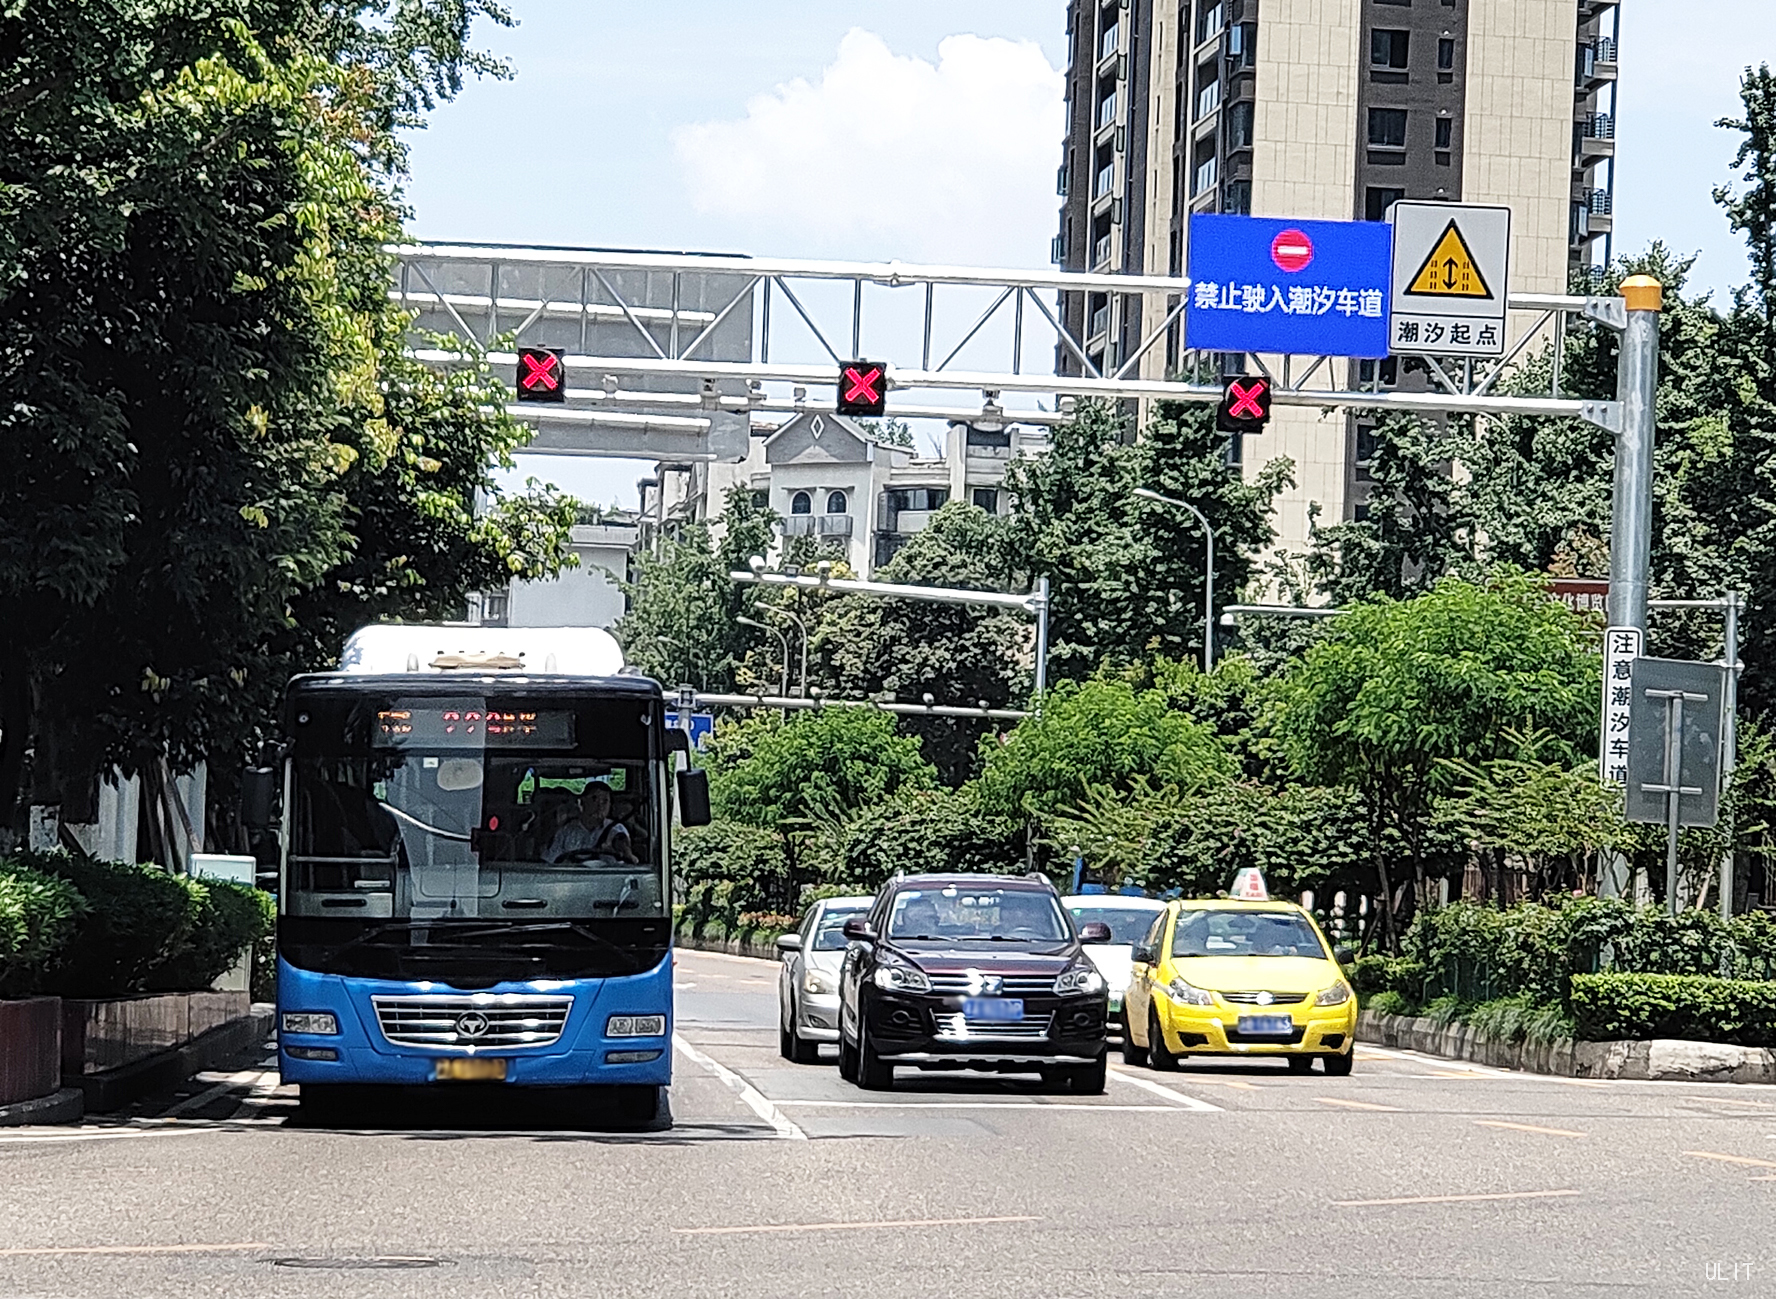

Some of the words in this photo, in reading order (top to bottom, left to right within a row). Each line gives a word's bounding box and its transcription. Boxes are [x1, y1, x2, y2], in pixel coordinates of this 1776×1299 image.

[1194, 281, 1383, 318] 禁止驶入潮汐车道
[1397, 320, 1497, 346] 潮汐起点
[1609, 633, 1634, 787] 注意潮汐车道
